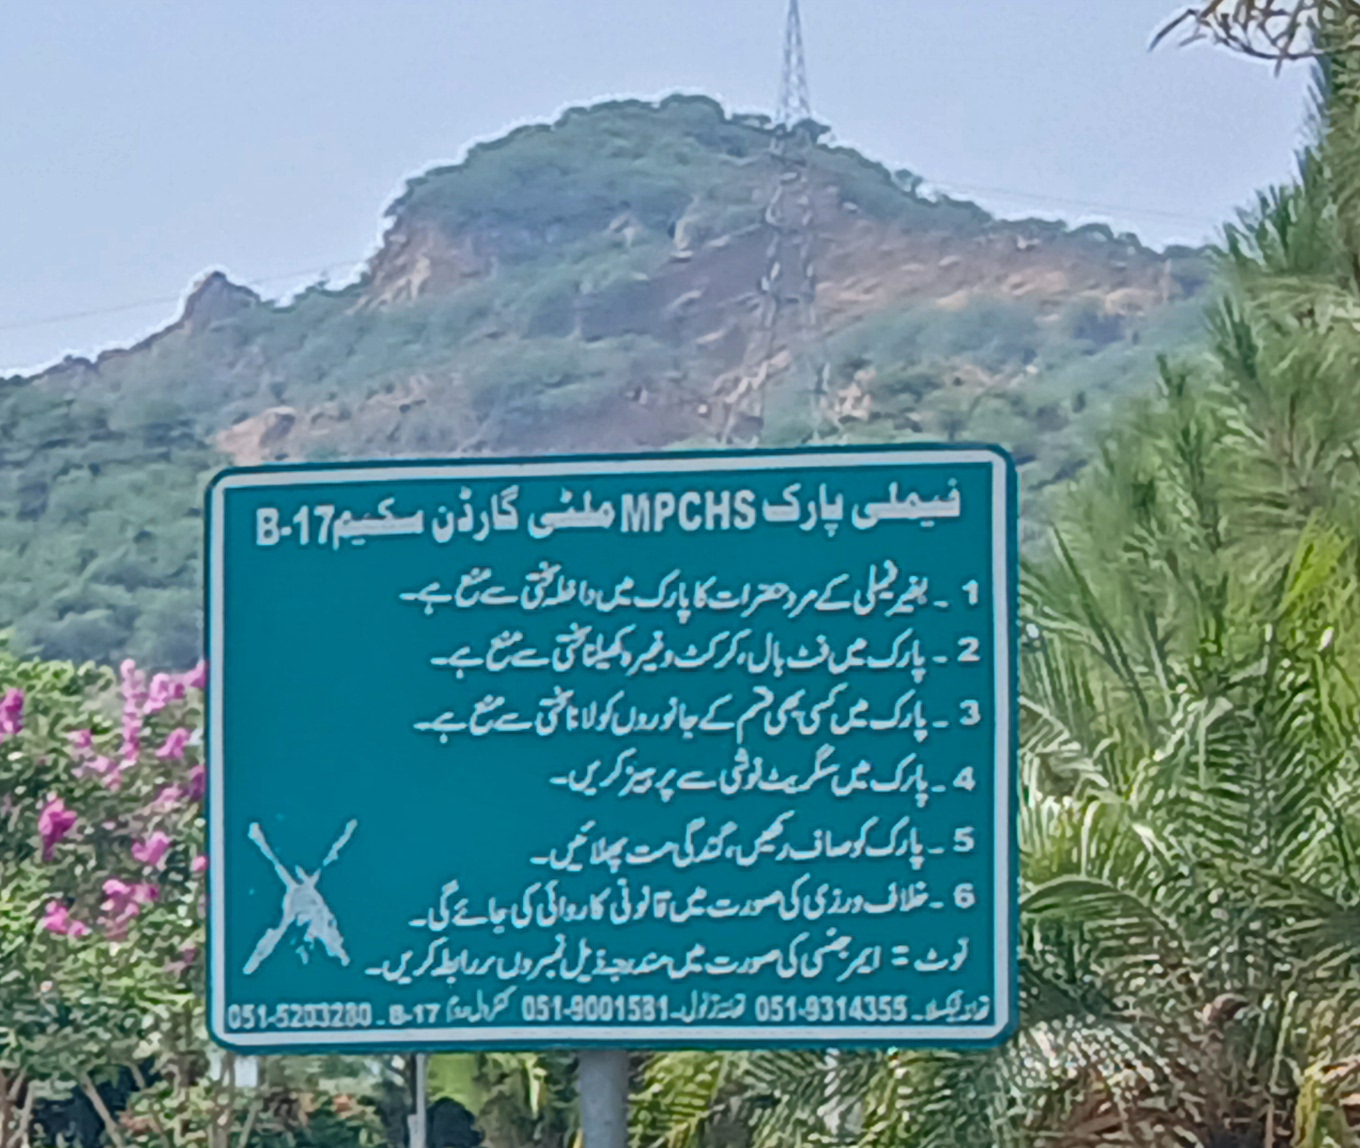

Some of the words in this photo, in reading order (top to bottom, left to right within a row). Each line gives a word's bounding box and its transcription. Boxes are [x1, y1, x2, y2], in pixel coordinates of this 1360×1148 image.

[432, 485, 520, 543] گارڈن
[528, 486, 616, 540] ملٹی
[620, 489, 757, 533] MPCHS
[762, 482, 844, 537] پارک
[851, 478, 961, 530] فیملی
[256, 504, 335, 546] B-17
[332, 497, 424, 551] سکیم
[454, 567, 492, 607] منع
[480, 586, 519, 606] سے
[596, 576, 634, 612] میں
[633, 568, 691, 624] پارک
[693, 575, 717, 608] کا
[815, 573, 852, 611] کے
[486, 630, 523, 671] منع
[510, 649, 550, 667] سے
[828, 638, 868, 674] میں
[867, 628, 926, 683] پارک
[470, 694, 505, 736] منع
[494, 712, 533, 731] سے
[698, 693, 735, 730] کے
[830, 698, 868, 735] میں
[870, 689, 928, 742] پارک
[676, 770, 717, 789] سے
[831, 759, 872, 796] میں
[870, 752, 929, 808] پارک
[626, 841, 679, 864] مت
[850, 816, 879, 858] کو
[865, 816, 925, 870] پارک
[669, 886, 707, 922] میں
[706, 890, 783, 917] صورت
[779, 873, 810, 921] کی
[863, 880, 929, 913] خلاف
[668, 943, 705, 980] میں
[705, 949, 780, 975] صورت
[776, 931, 810, 978] کی
[913, 936, 970, 972] نوٹ
[389, 1003, 441, 1025] B-17
[754, 994, 908, 1022] 051-9314355
